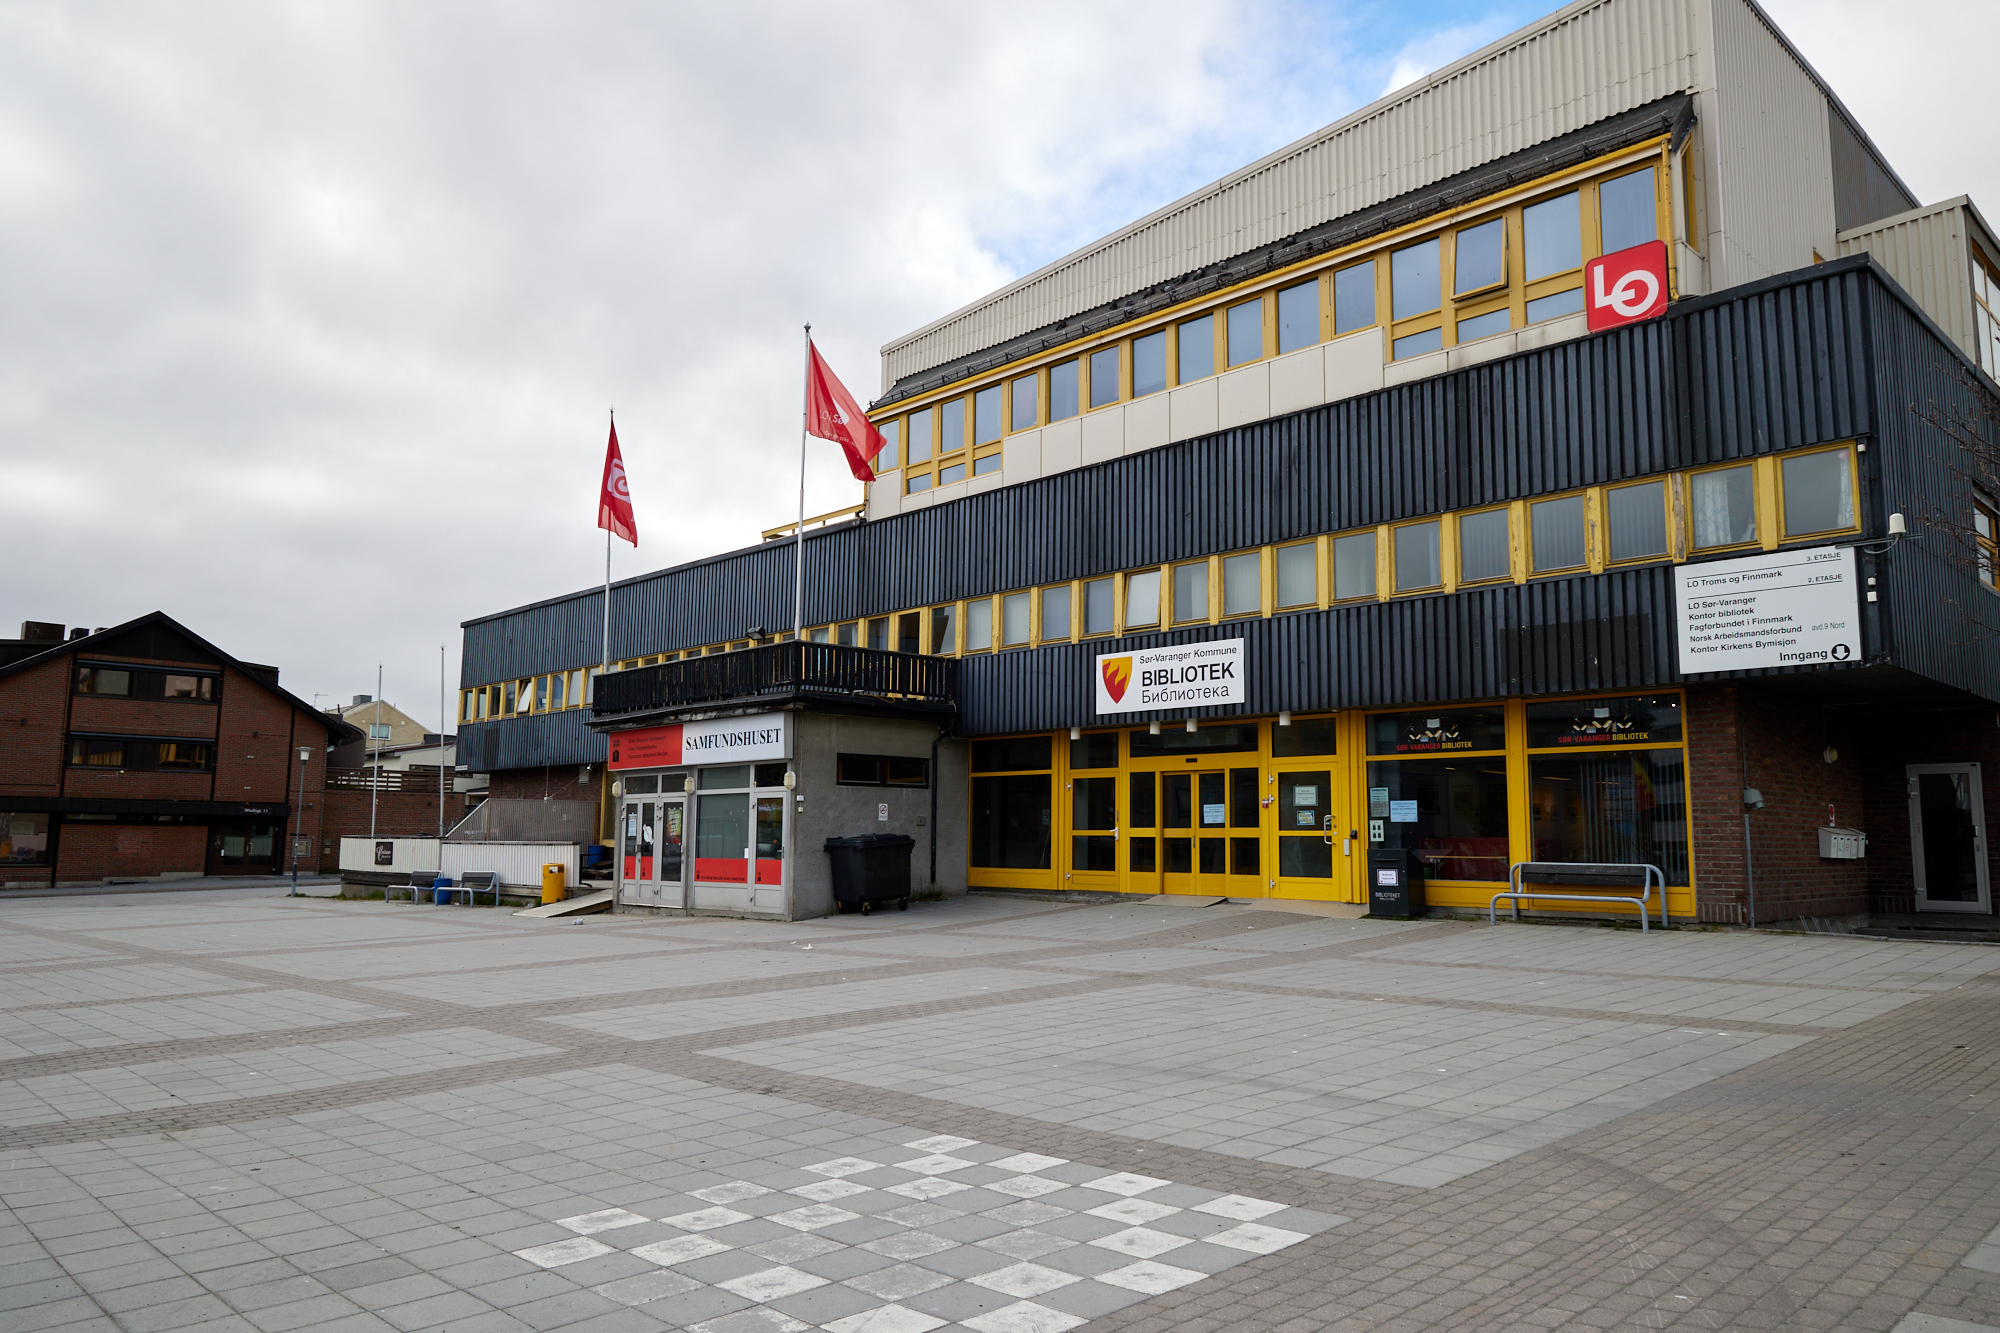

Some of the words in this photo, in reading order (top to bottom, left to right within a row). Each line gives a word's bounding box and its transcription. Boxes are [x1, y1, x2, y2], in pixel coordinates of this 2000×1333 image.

[1593, 264, 1659, 317] LO
[1814, 552, 1841, 560] ETASJE
[1687, 580, 1699, 588] LO
[1701, 576, 1727, 586] Troms
[1729, 576, 1739, 584] og
[1742, 571, 1782, 581] Finnmark
[1815, 574, 1842, 582] ETASJE
[1702, 597, 1756, 607] Sør-Varanger
[1689, 611, 1716, 620] Kontor
[1718, 608, 1754, 617] bibliotek
[1689, 620, 1744, 632] Fagforbundet
[1752, 615, 1792, 625] Finnmark
[1690, 634, 1712, 642] Norsk
[1714, 626, 1802, 640] Arbeidsmandsforbund
[1691, 644, 1718, 653] Kontor
[1721, 641, 1753, 651] Kirkens
[1755, 638, 1796, 649] Bymisjon
[1140, 652, 1191, 664] Sør-Varanger
[1194, 647, 1237, 658] Kommune
[1780, 650, 1828, 662] Inngang
[1142, 662, 1234, 686] BIBLIOTEK
[1142, 686, 1229, 704] Библиотека
[686, 729, 781, 750] SAMFUNDSHUSET
[1558, 733, 1611, 744] SØR-VARANGER
[1612, 732, 1649, 741] BIBLIOTEK
[1396, 743, 1441, 751] SØR-VARANGER
[1442, 741, 1472, 749] BIBLIOTEK
